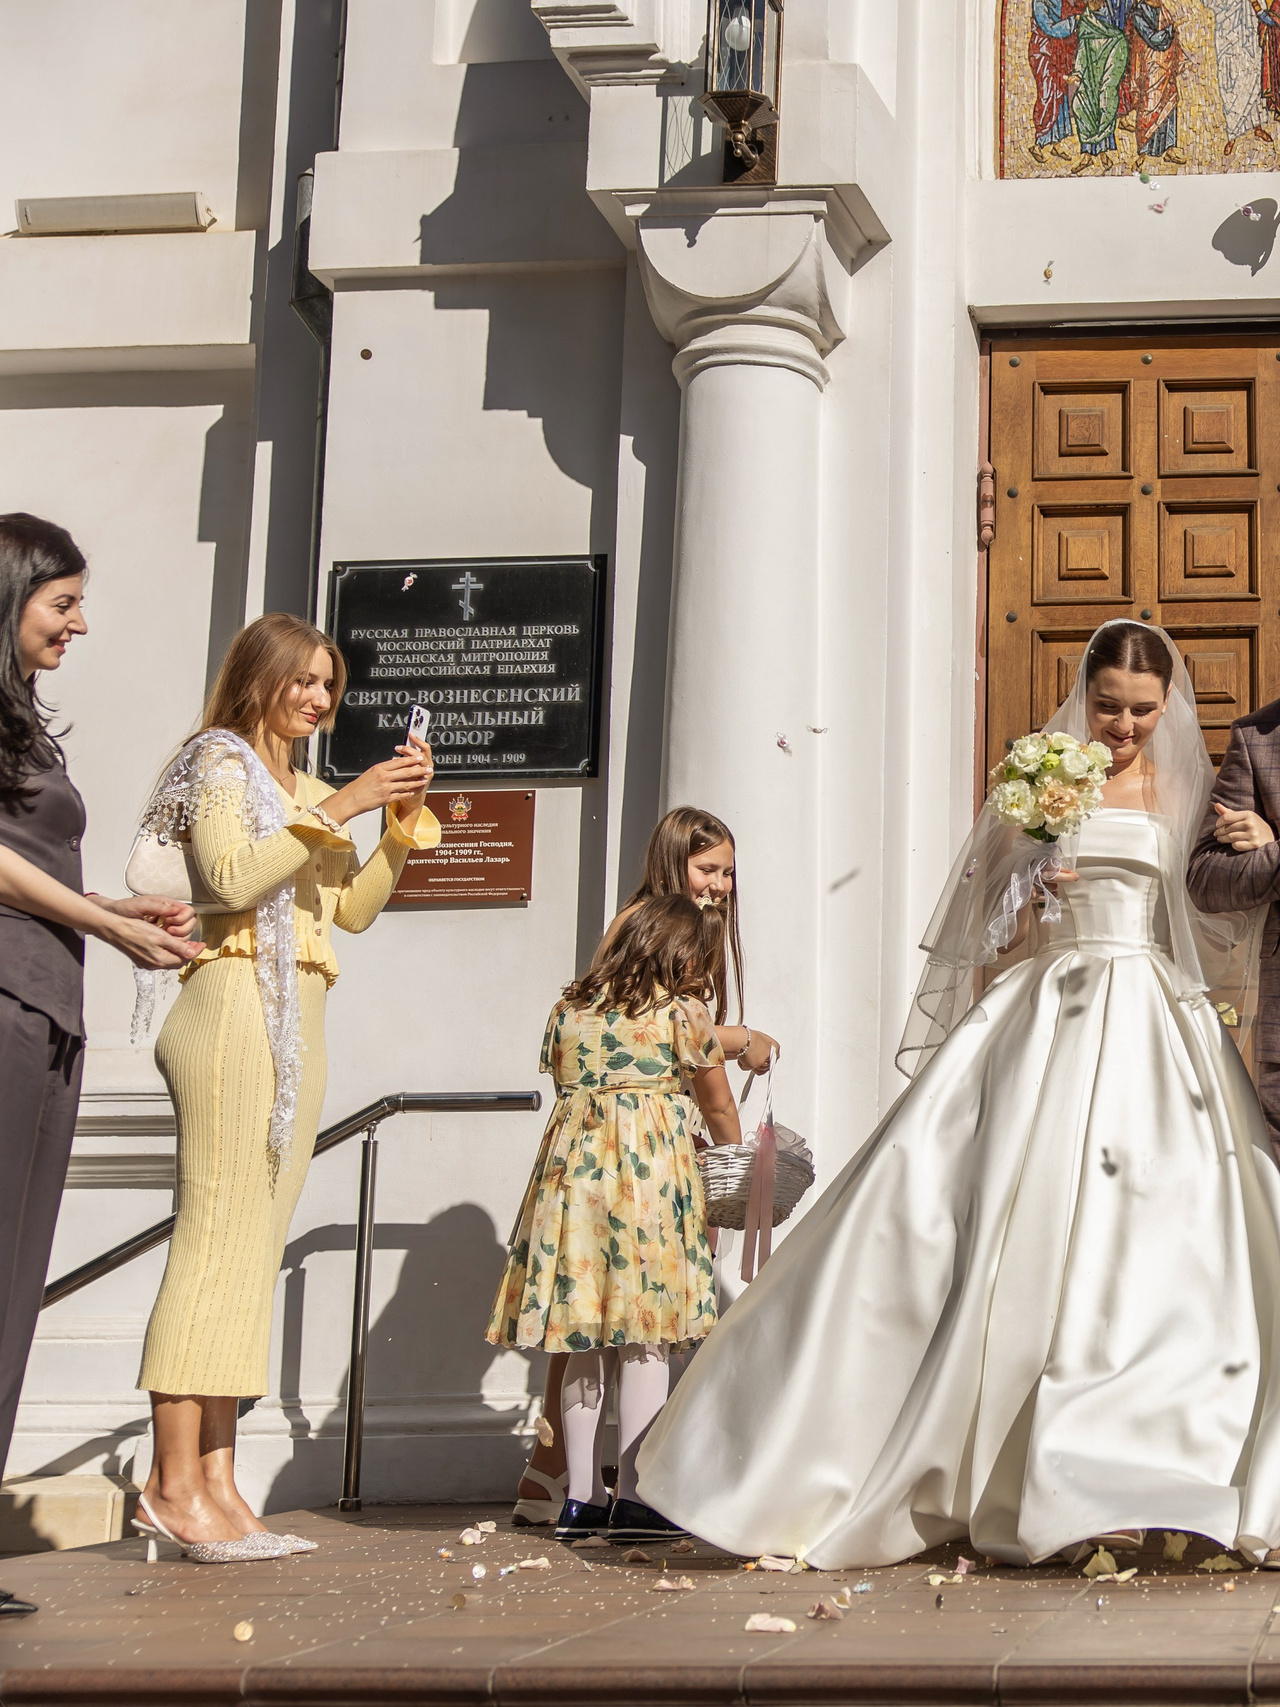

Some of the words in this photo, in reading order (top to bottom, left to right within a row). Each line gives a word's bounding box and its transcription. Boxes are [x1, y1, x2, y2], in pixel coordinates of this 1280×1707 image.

[351, 628, 408, 640] РУССКАЯ
[415, 626, 516, 638] ПРАВОСЛАВНАЯ
[522, 625, 579, 637] ЦЕРКОВЬ
[376, 638, 464, 651] МОСКОВСКИЙ
[471, 638, 553, 649] ПАТРИАРХАТ
[378, 653, 455, 665] КУБАНСКАЯ
[461, 651, 549, 663] МИТРОПОЛИЯ
[370, 663, 491, 677] НОВОРОССИЙСКАЯ
[497, 664, 556, 675] ЕПАРХИЯ
[344, 683, 581, 706] СВЯТО-ВОЗНЕСЕНСКИЙ
[377, 707, 545, 729] КАДРАЛЬНЫЙ
[426, 731, 495, 746] СОБОР
[466, 754, 490, 764] 1904
[502, 753, 526, 763] 1909
[479, 840, 514, 848] Господня,
[407, 858, 448, 866] архитектор
